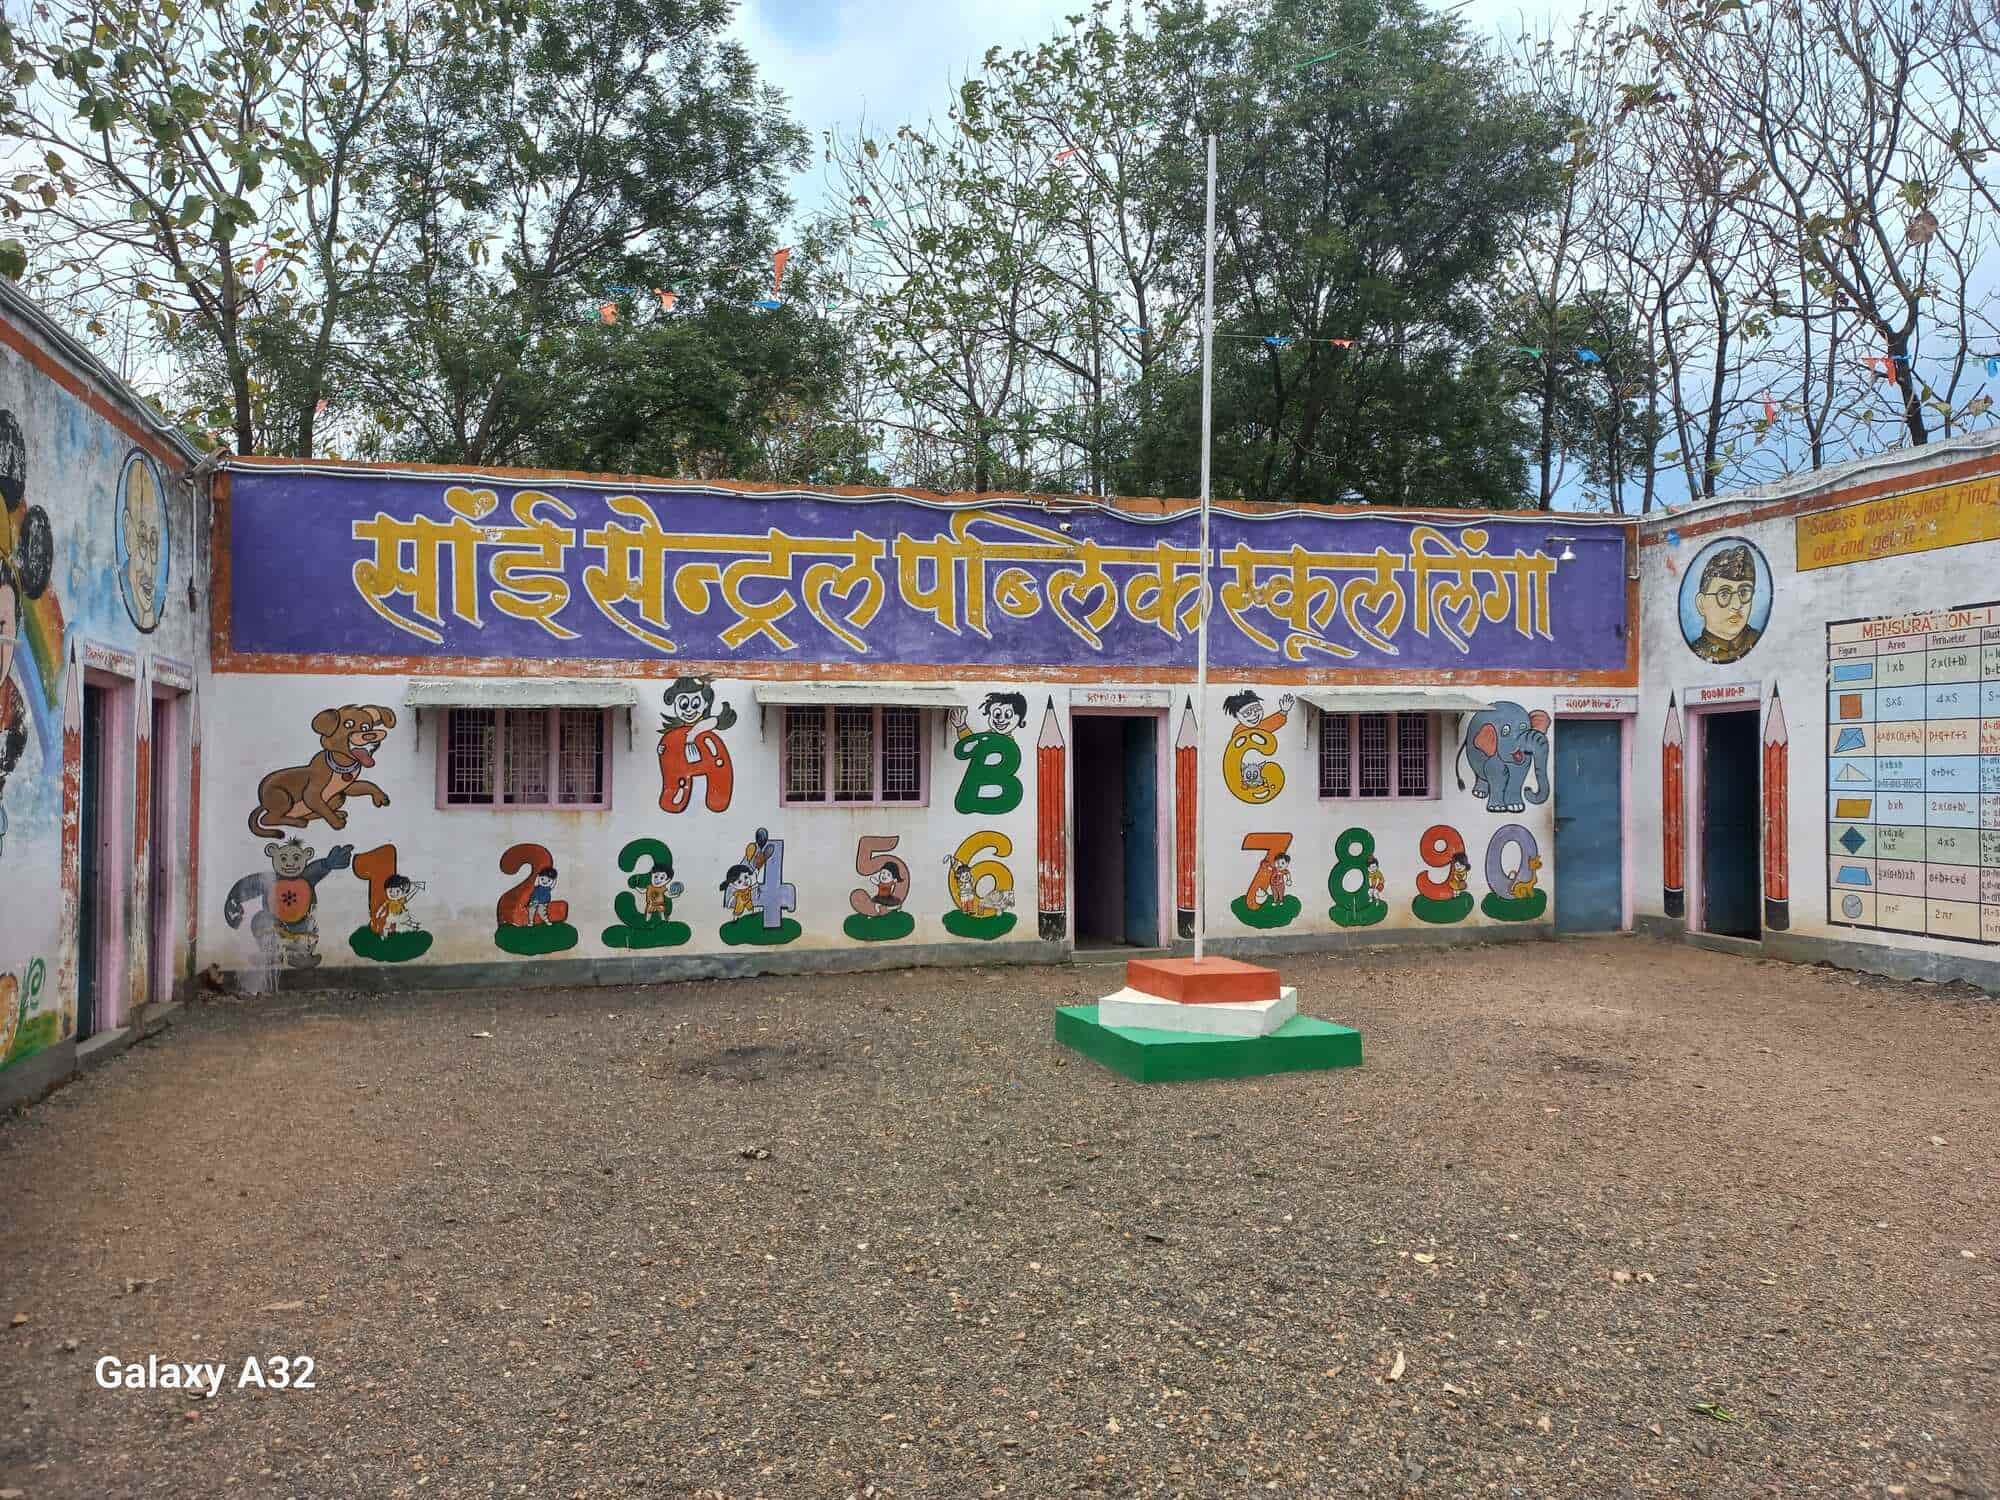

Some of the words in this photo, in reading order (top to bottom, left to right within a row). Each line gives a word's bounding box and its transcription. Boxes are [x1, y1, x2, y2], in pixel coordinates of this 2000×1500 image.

[582, 495, 885, 654] सेन्ट्रल
[893, 510, 1213, 651] पब्लिक
[1219, 543, 1405, 662] स्कूल
[1408, 526, 1557, 654] लिंगा
[1840, 537, 1865, 556] and
[1887, 640, 1906, 651] Area
[954, 732, 1023, 814] B
[499, 843, 568, 927] 2
[614, 838, 674, 928] 3
[724, 838, 796, 929] 4
[850, 835, 910, 917] 5
[948, 830, 1014, 918] 6
[1241, 832, 1293, 911] 7
[1328, 827, 1376, 910] 8
[1416, 824, 1467, 901] 9
